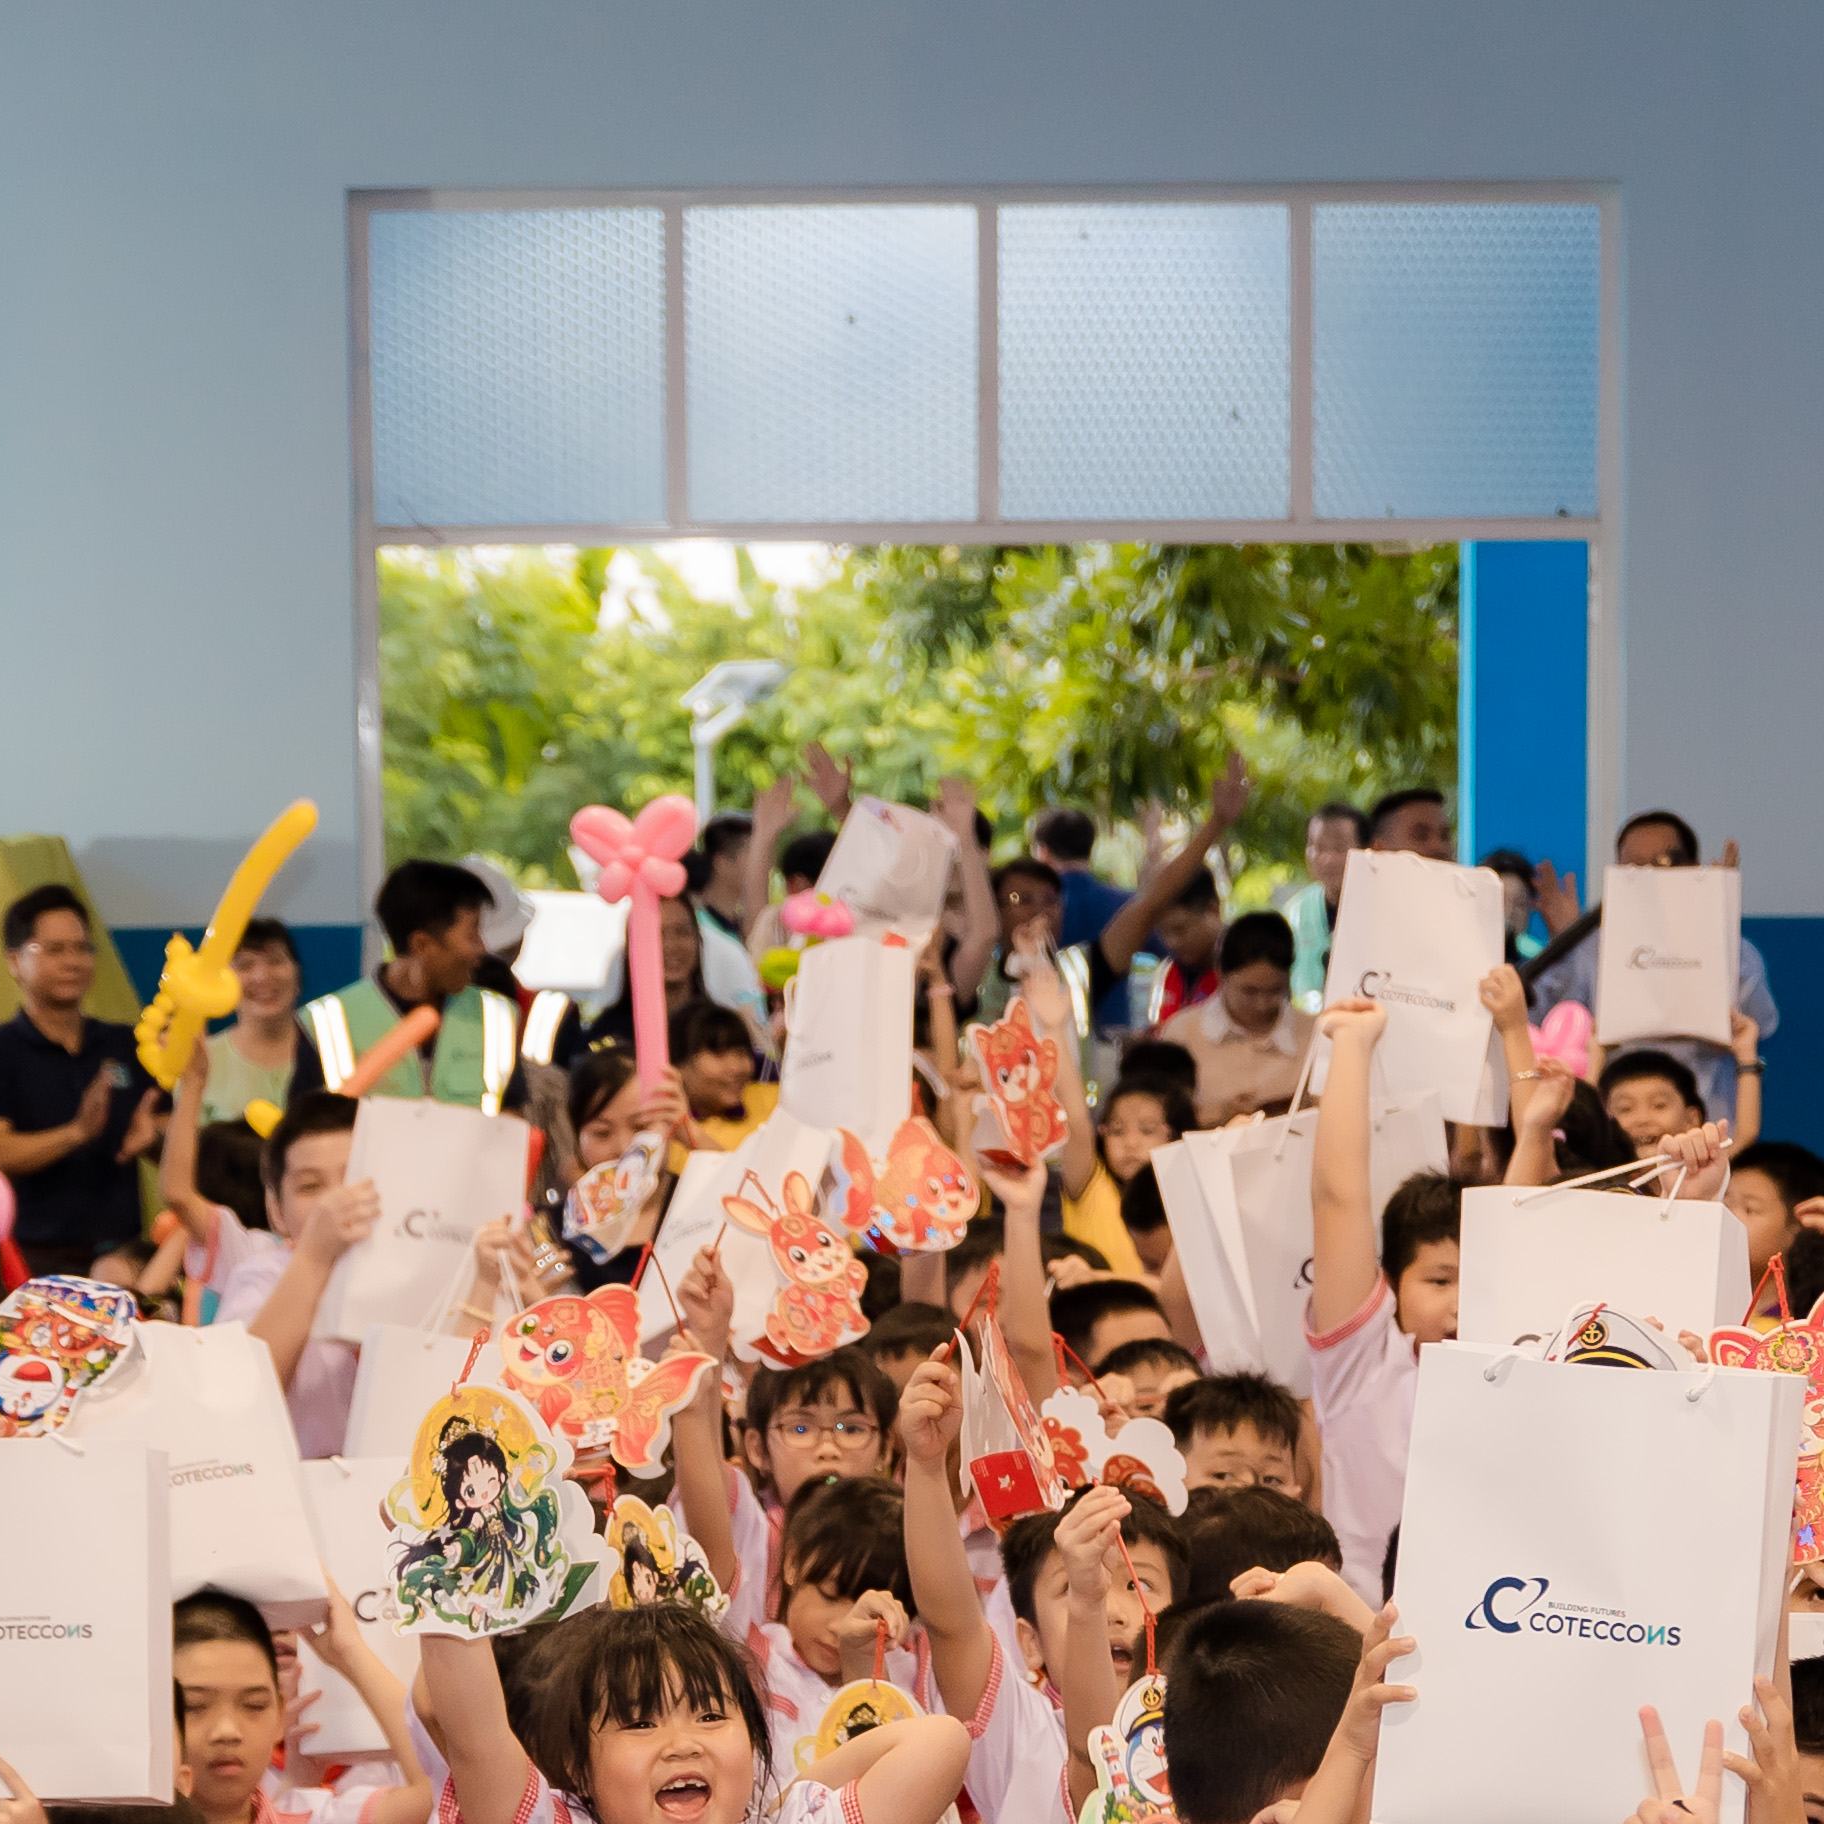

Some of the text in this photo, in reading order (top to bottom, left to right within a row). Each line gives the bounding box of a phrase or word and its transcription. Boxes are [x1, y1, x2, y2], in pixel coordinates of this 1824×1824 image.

[169, 1463, 254, 1487] OTECCONS
[1548, 1602, 1626, 1617] BUILDING FUTURES
[1530, 1613, 1680, 1646] COTECCONS
